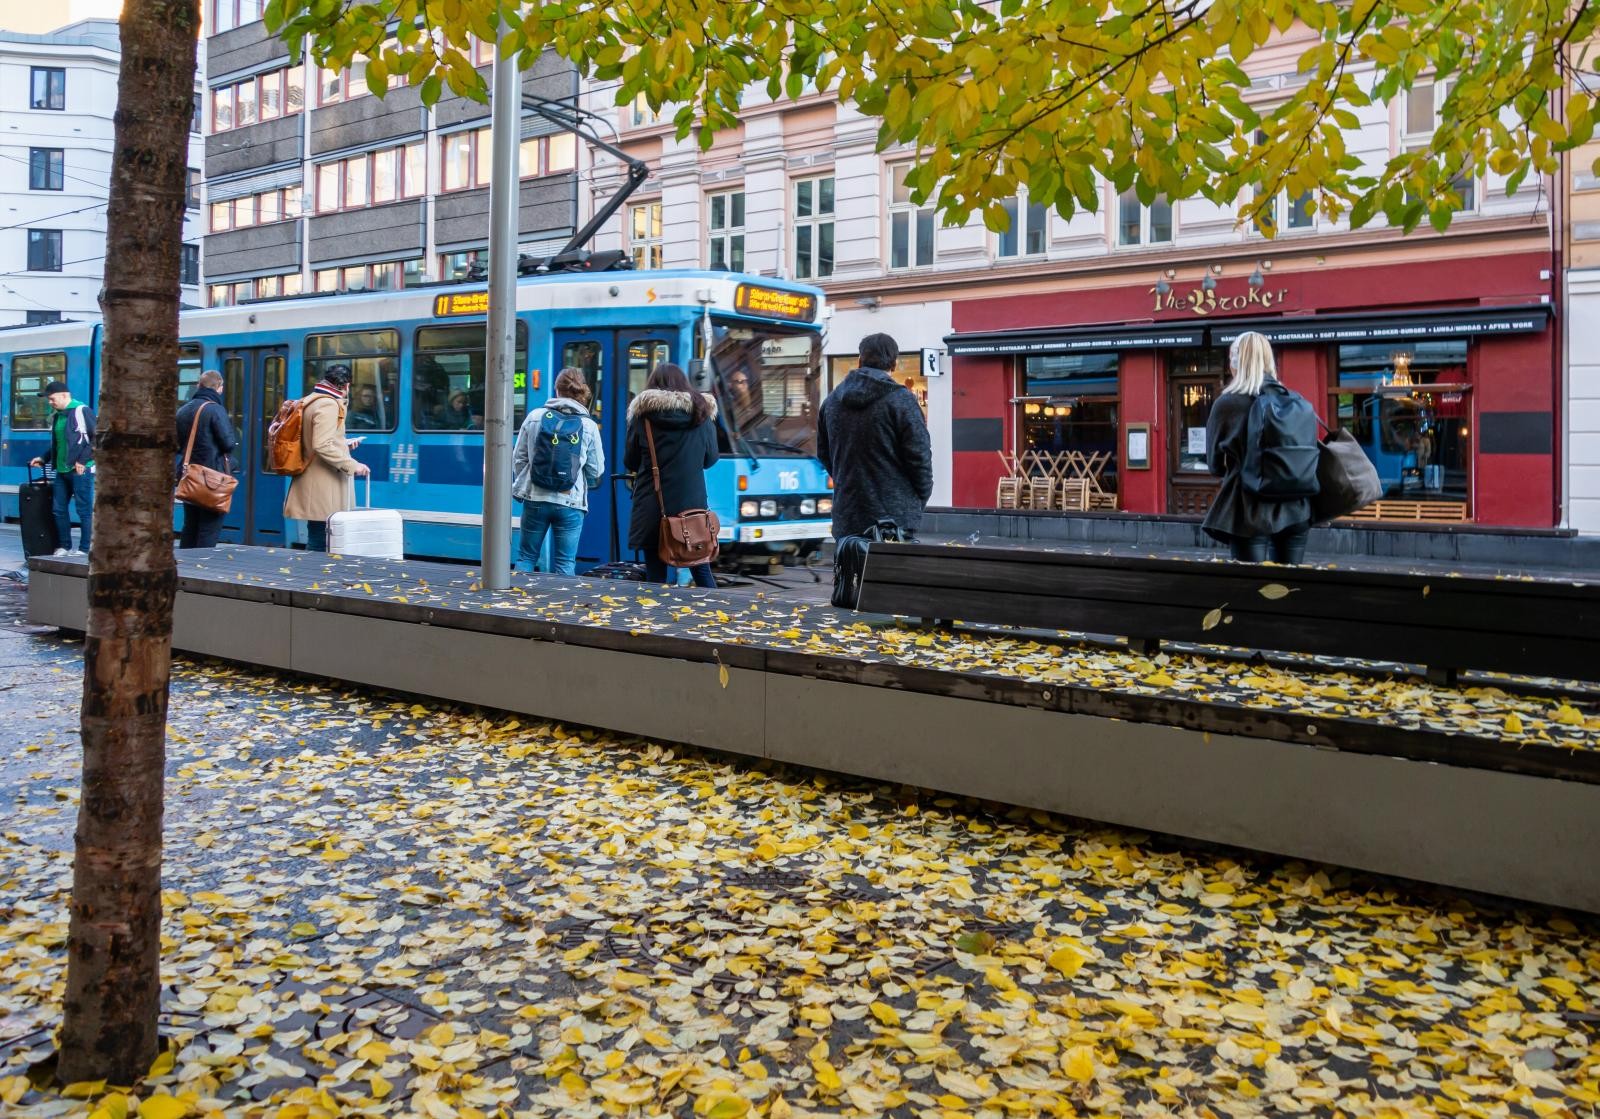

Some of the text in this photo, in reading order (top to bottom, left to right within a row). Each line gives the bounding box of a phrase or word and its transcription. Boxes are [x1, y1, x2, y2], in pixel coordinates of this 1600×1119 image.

[436, 296, 450, 315] 11
[1148, 287, 1289, 315] The Broker
